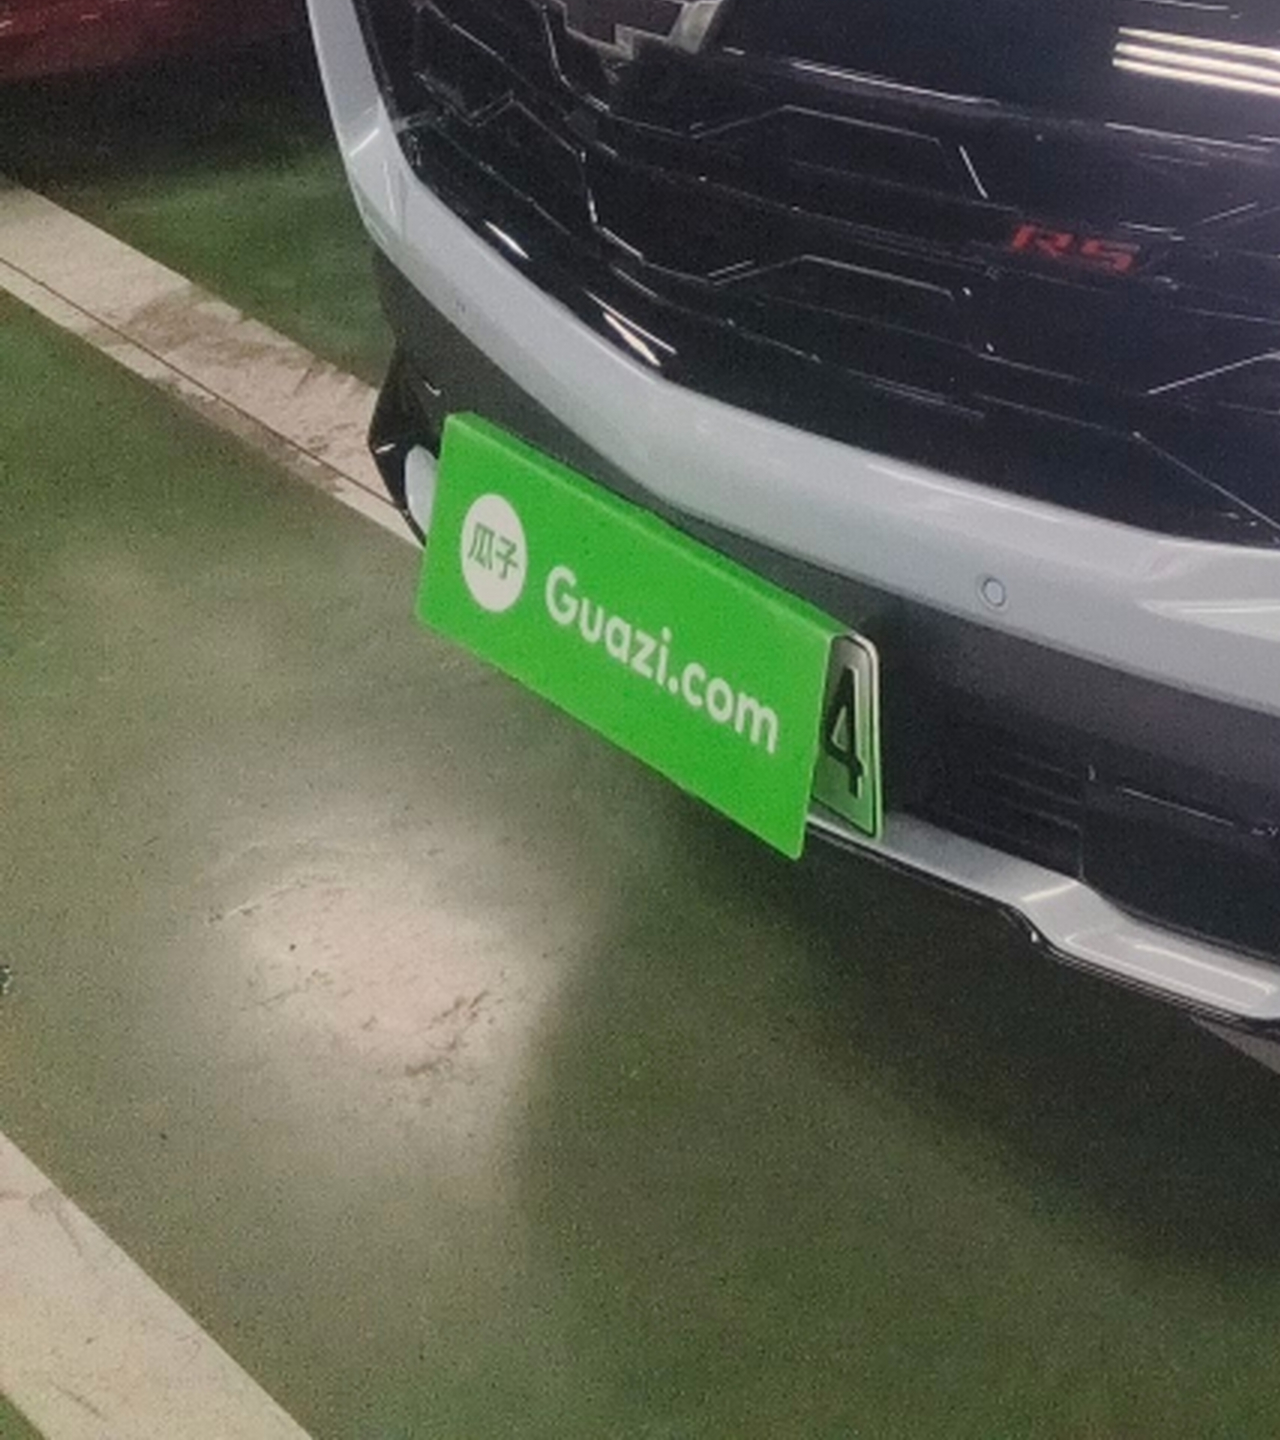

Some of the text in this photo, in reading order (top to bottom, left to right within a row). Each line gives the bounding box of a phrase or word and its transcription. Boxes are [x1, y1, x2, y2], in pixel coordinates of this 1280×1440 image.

[1010, 223, 1141, 274] RS
[467, 521, 518, 580] 瓜子
[544, 566, 779, 753] Guazi.com
[821, 666, 865, 799] 4
